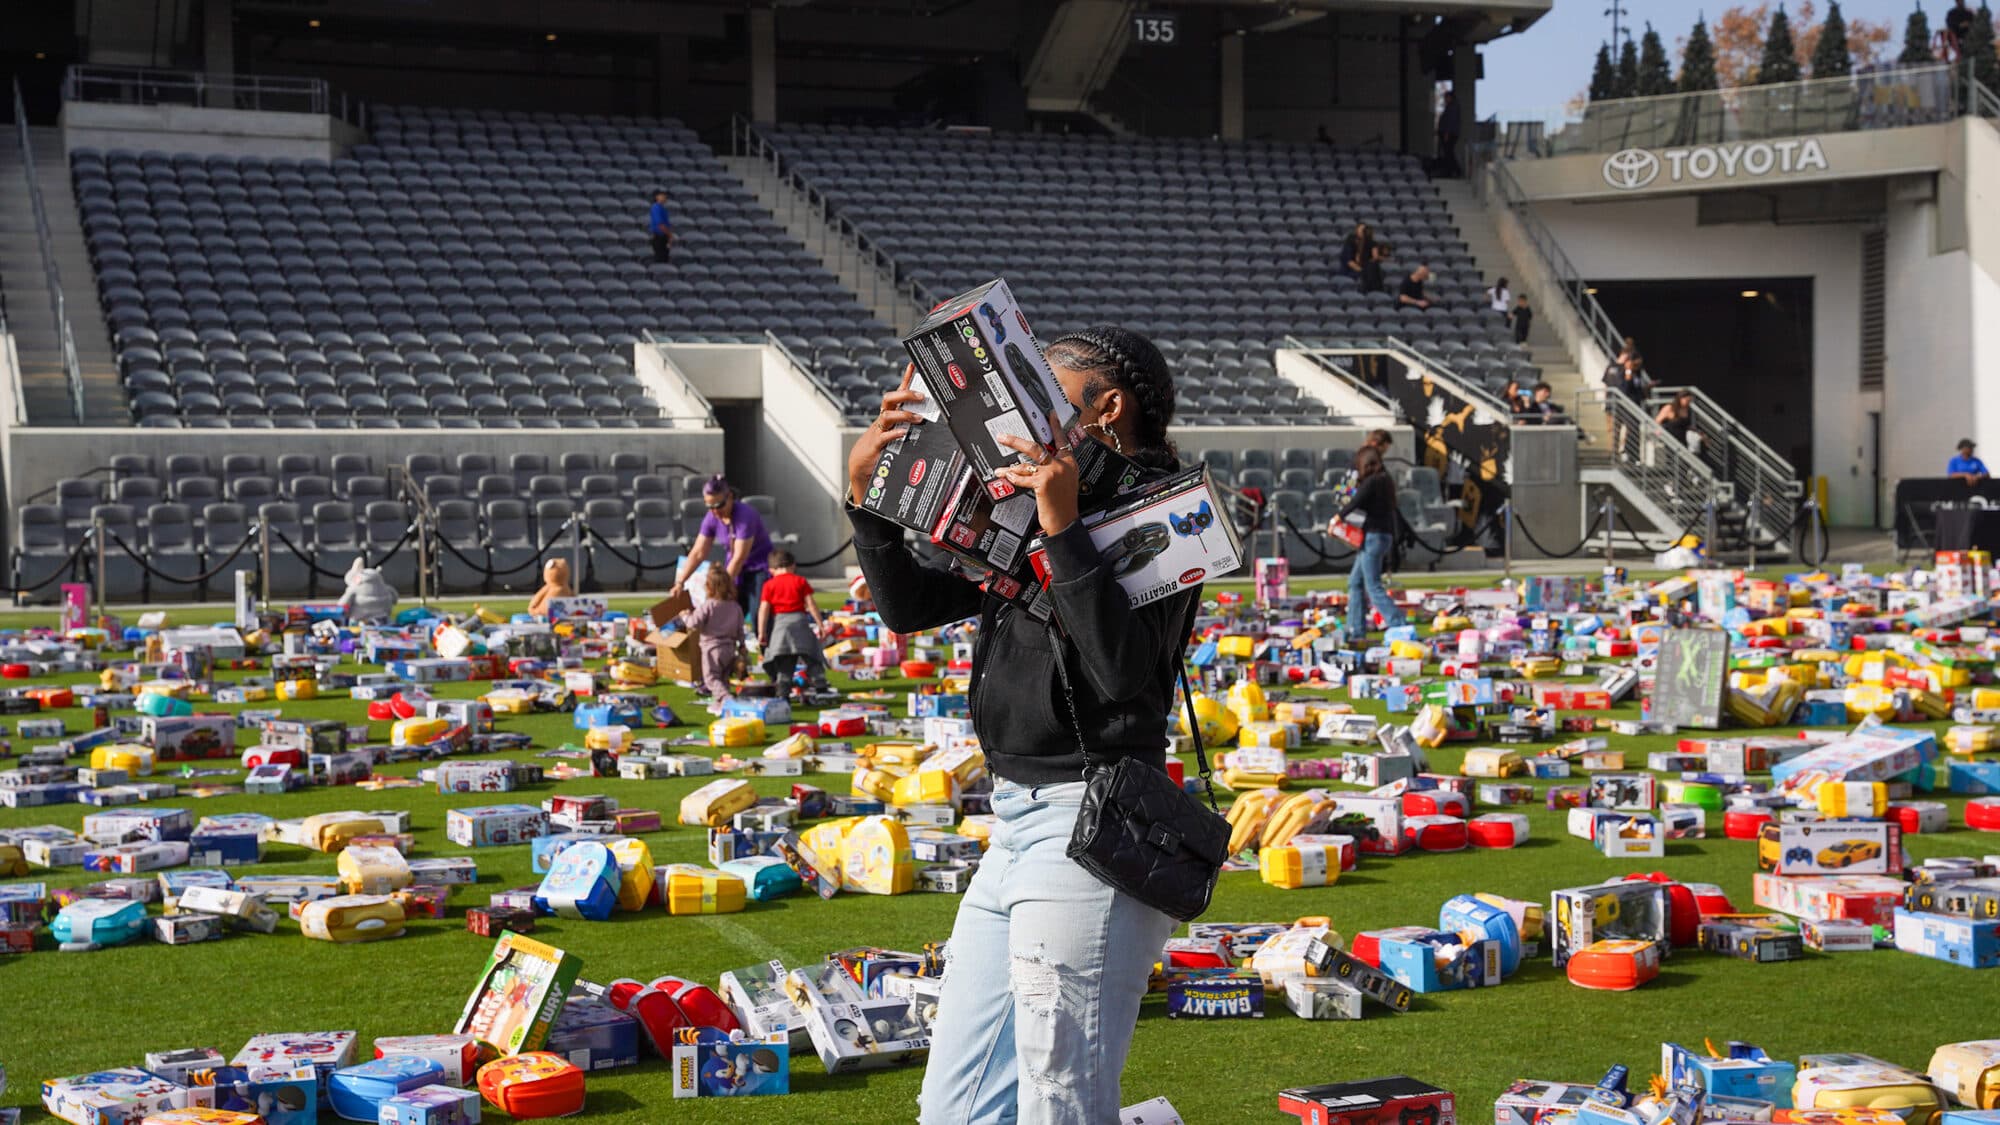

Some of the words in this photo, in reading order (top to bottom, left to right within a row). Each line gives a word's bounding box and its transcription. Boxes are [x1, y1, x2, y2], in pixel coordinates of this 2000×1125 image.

[1135, 19, 1174, 42] 135
[1664, 139, 1828, 181] TOYOTA
[911, 461, 924, 483] BUGATTI
[1181, 569, 1204, 583] BUGATTI
[1141, 580, 1178, 603] BUGATTI
[1184, 989, 1220, 1000] TRACK
[1222, 989, 1249, 999] FLEX
[526, 981, 564, 1051] SUBWAY
[1182, 996, 1252, 1015] GALAXY
[681, 1056, 689, 1089] SONIC
